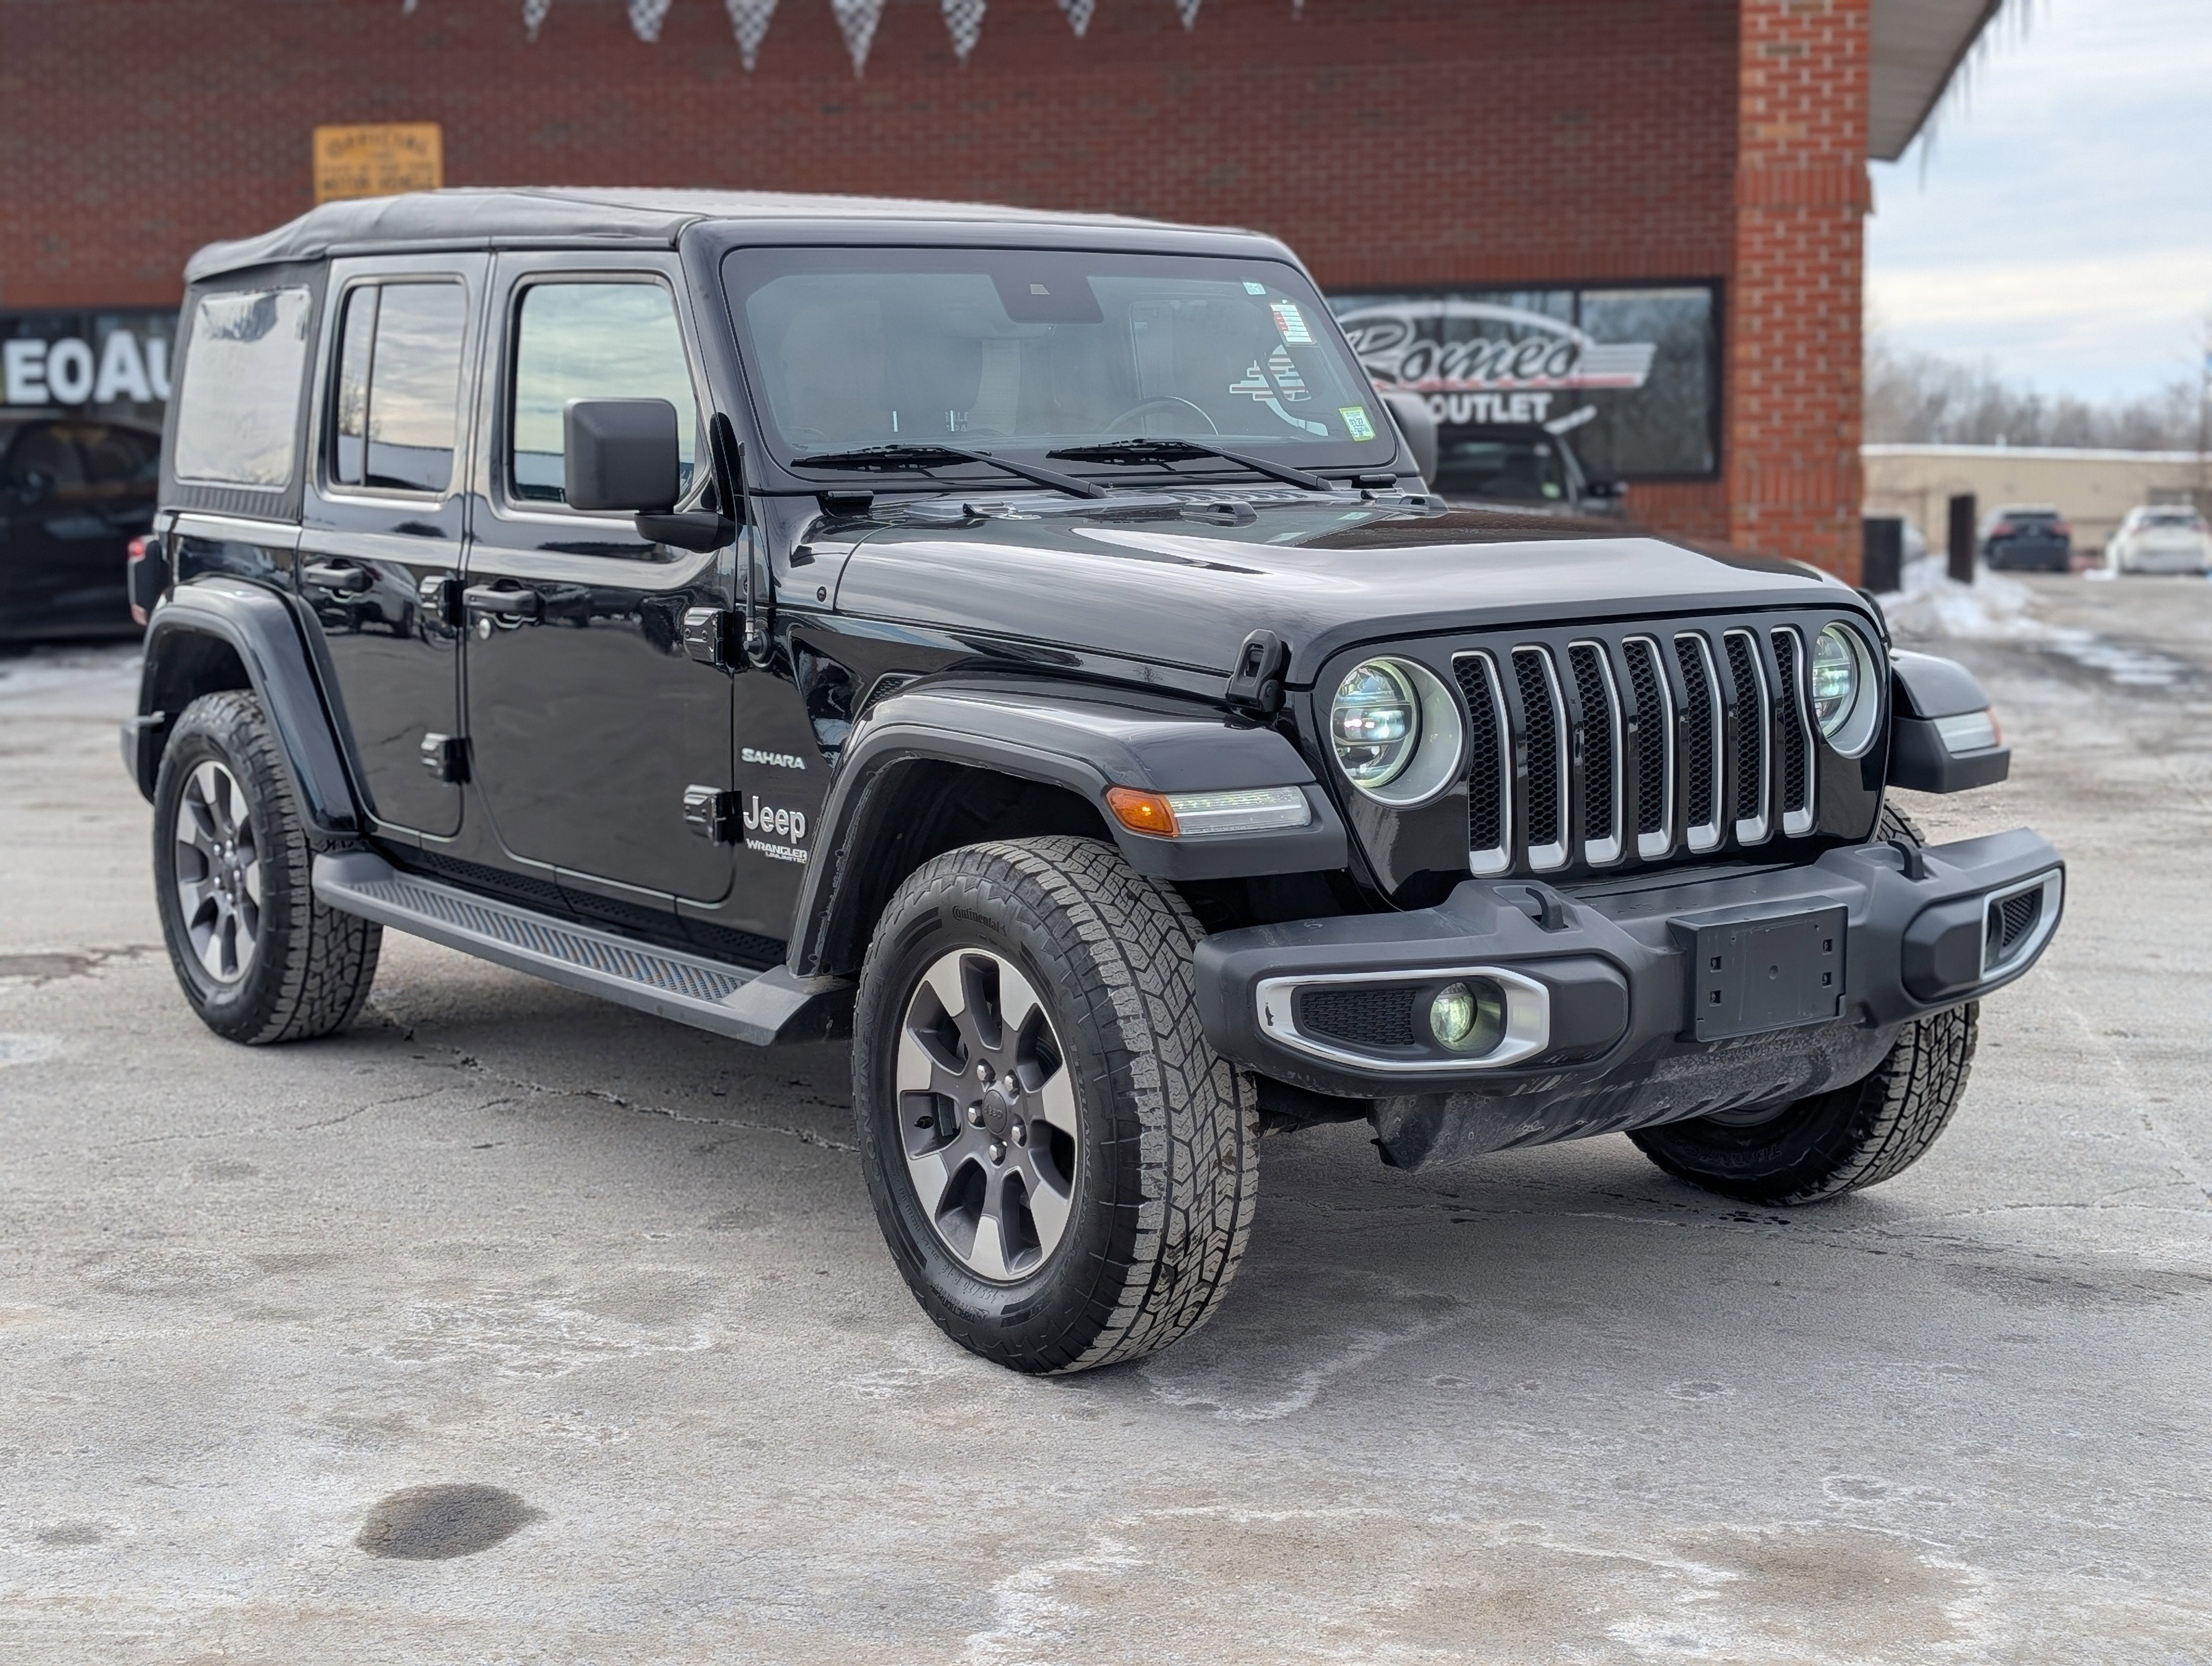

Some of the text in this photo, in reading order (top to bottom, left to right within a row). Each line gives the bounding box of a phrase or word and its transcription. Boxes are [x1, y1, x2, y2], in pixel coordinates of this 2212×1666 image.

[1347, 316, 1581, 384] Romeo
[1426, 393, 1552, 425] OUTLET
[741, 747, 807, 770] SAHARA
[743, 795, 806, 844] Jeep
[745, 838, 808, 860] WRANGLER
[952, 905, 1000, 933] Continental
